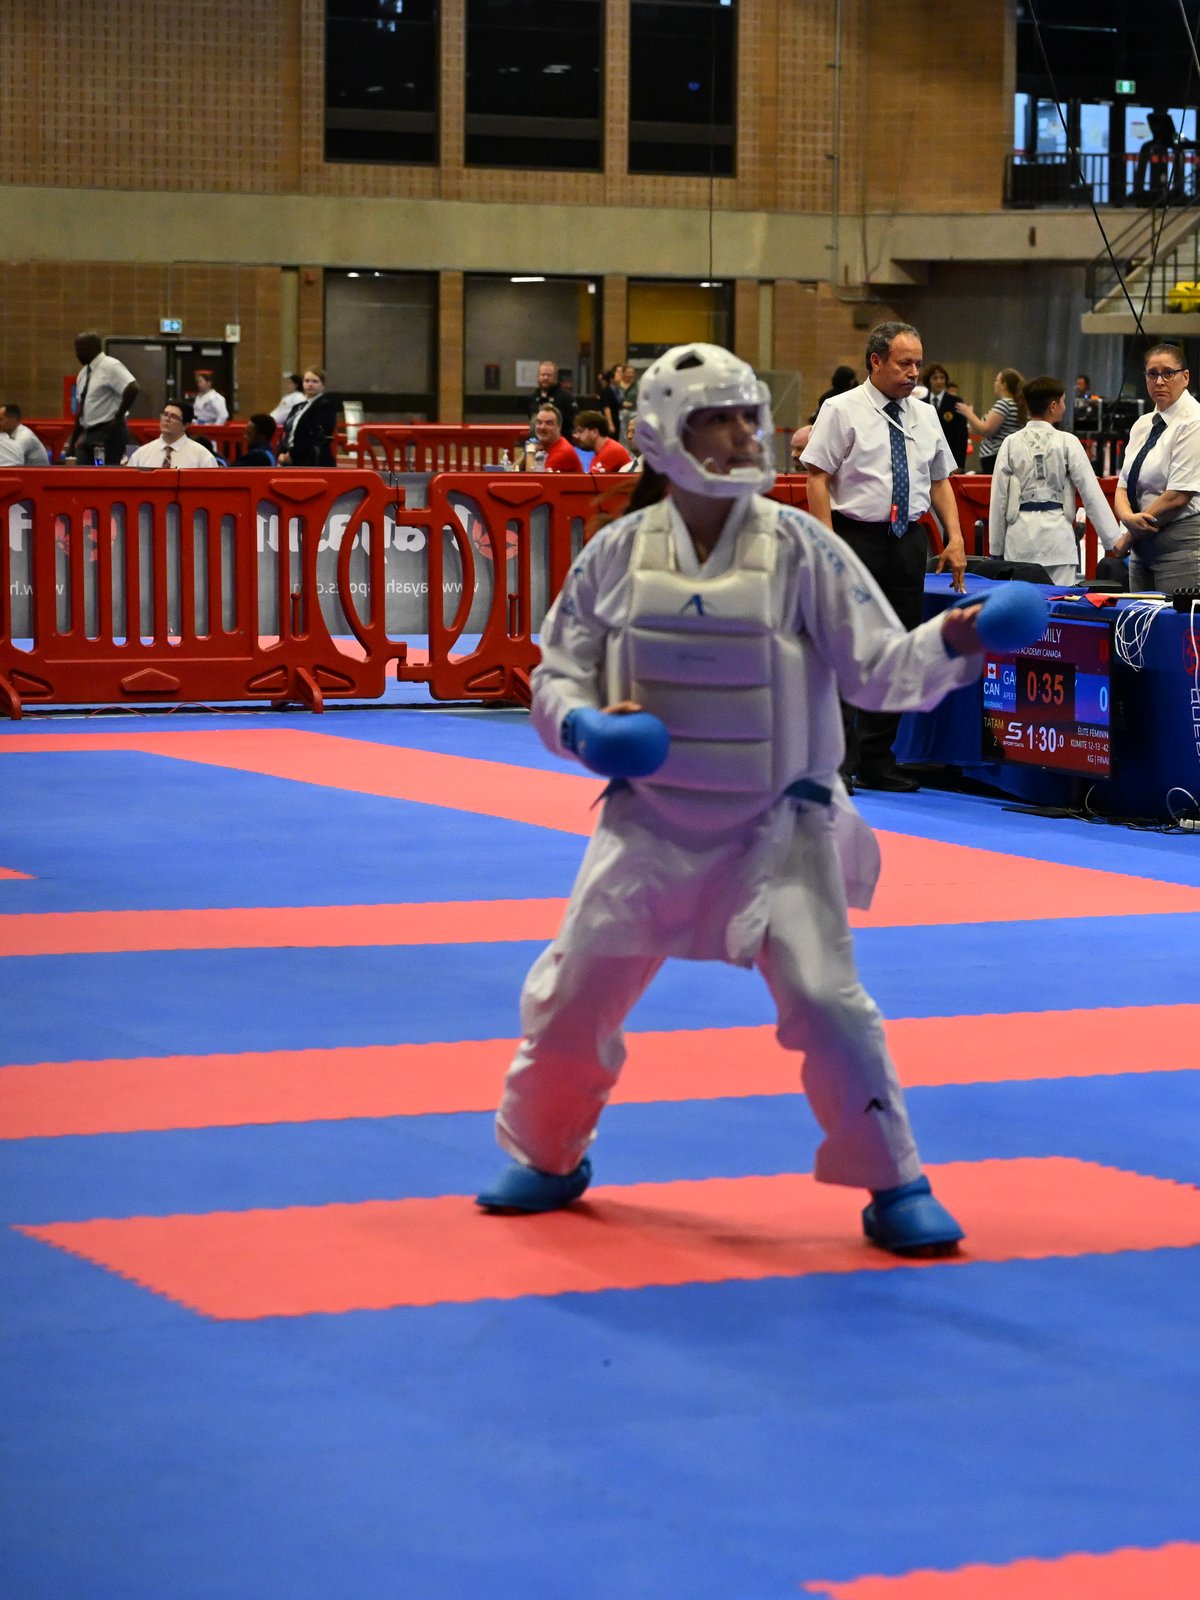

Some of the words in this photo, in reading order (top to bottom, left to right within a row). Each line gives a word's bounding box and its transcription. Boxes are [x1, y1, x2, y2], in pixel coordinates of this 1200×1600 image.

[1038, 628, 1062, 643] MILY
[1042, 649, 1062, 658] CANADA
[1003, 670, 1016, 686] GA
[983, 682, 1000, 696] CAN
[1027, 671, 1064, 705] 0:35
[1100, 686, 1108, 712] 0
[993, 735, 998, 746] 2
